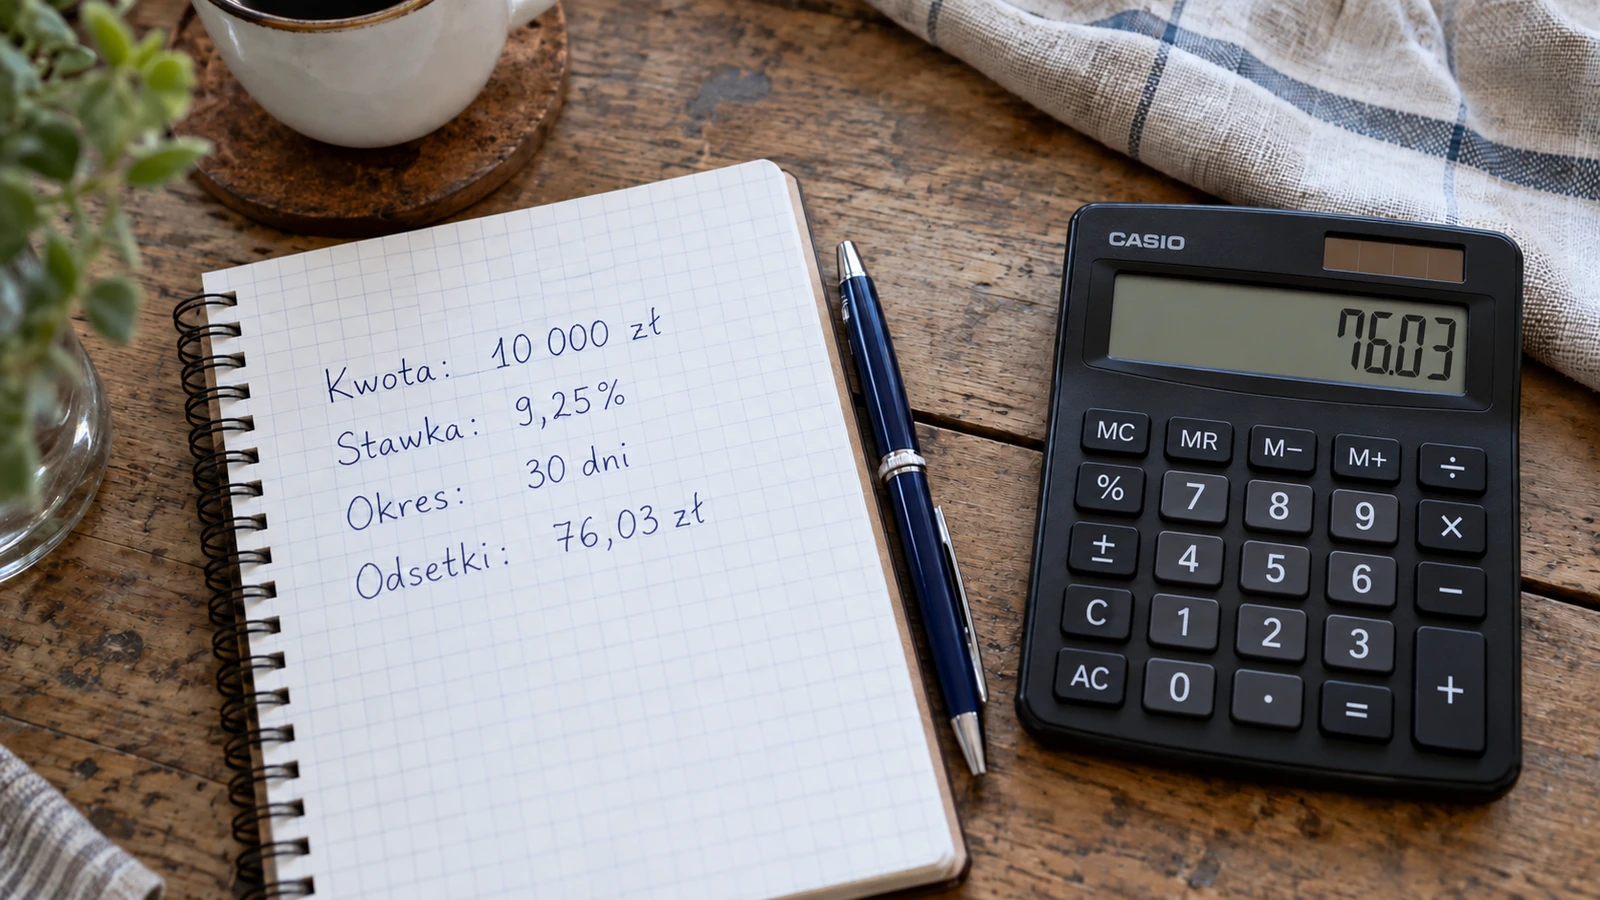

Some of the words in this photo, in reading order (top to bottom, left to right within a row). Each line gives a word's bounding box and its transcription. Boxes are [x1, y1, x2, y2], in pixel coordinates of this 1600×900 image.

[1108, 231, 1186, 251] CASIO
[325, 357, 450, 404] Kwota:
[491, 333, 532, 369] 10
[547, 319, 609, 357] 000
[630, 306, 662, 341] zł
[1336, 307, 1457, 382] 76.03
[337, 416, 478, 466] Stawka:
[515, 378, 625, 430] 9,25%
[1097, 420, 1135, 442] MC
[1181, 429, 1218, 451] MR
[1349, 447, 1387, 468] M+
[346, 487, 464, 531] Okres:
[526, 454, 566, 489] 30
[582, 442, 629, 477] dni
[1097, 474, 1124, 501] %
[1186, 482, 1206, 510] 7
[1268, 491, 1289, 521] 8
[1355, 501, 1375, 531] 9
[356, 542, 509, 600] Odsetki:
[552, 504, 659, 553] 76,03
[673, 491, 705, 528] zł
[1178, 544, 1199, 573] 4
[1265, 553, 1286, 583] 5
[1352, 563, 1372, 594] 6
[1086, 599, 1108, 626] C
[1177, 607, 1190, 637] 1
[1261, 617, 1282, 649] 2
[1349, 628, 1369, 659] 3
[1070, 664, 1110, 690] AC
[1169, 671, 1190, 702] 0
